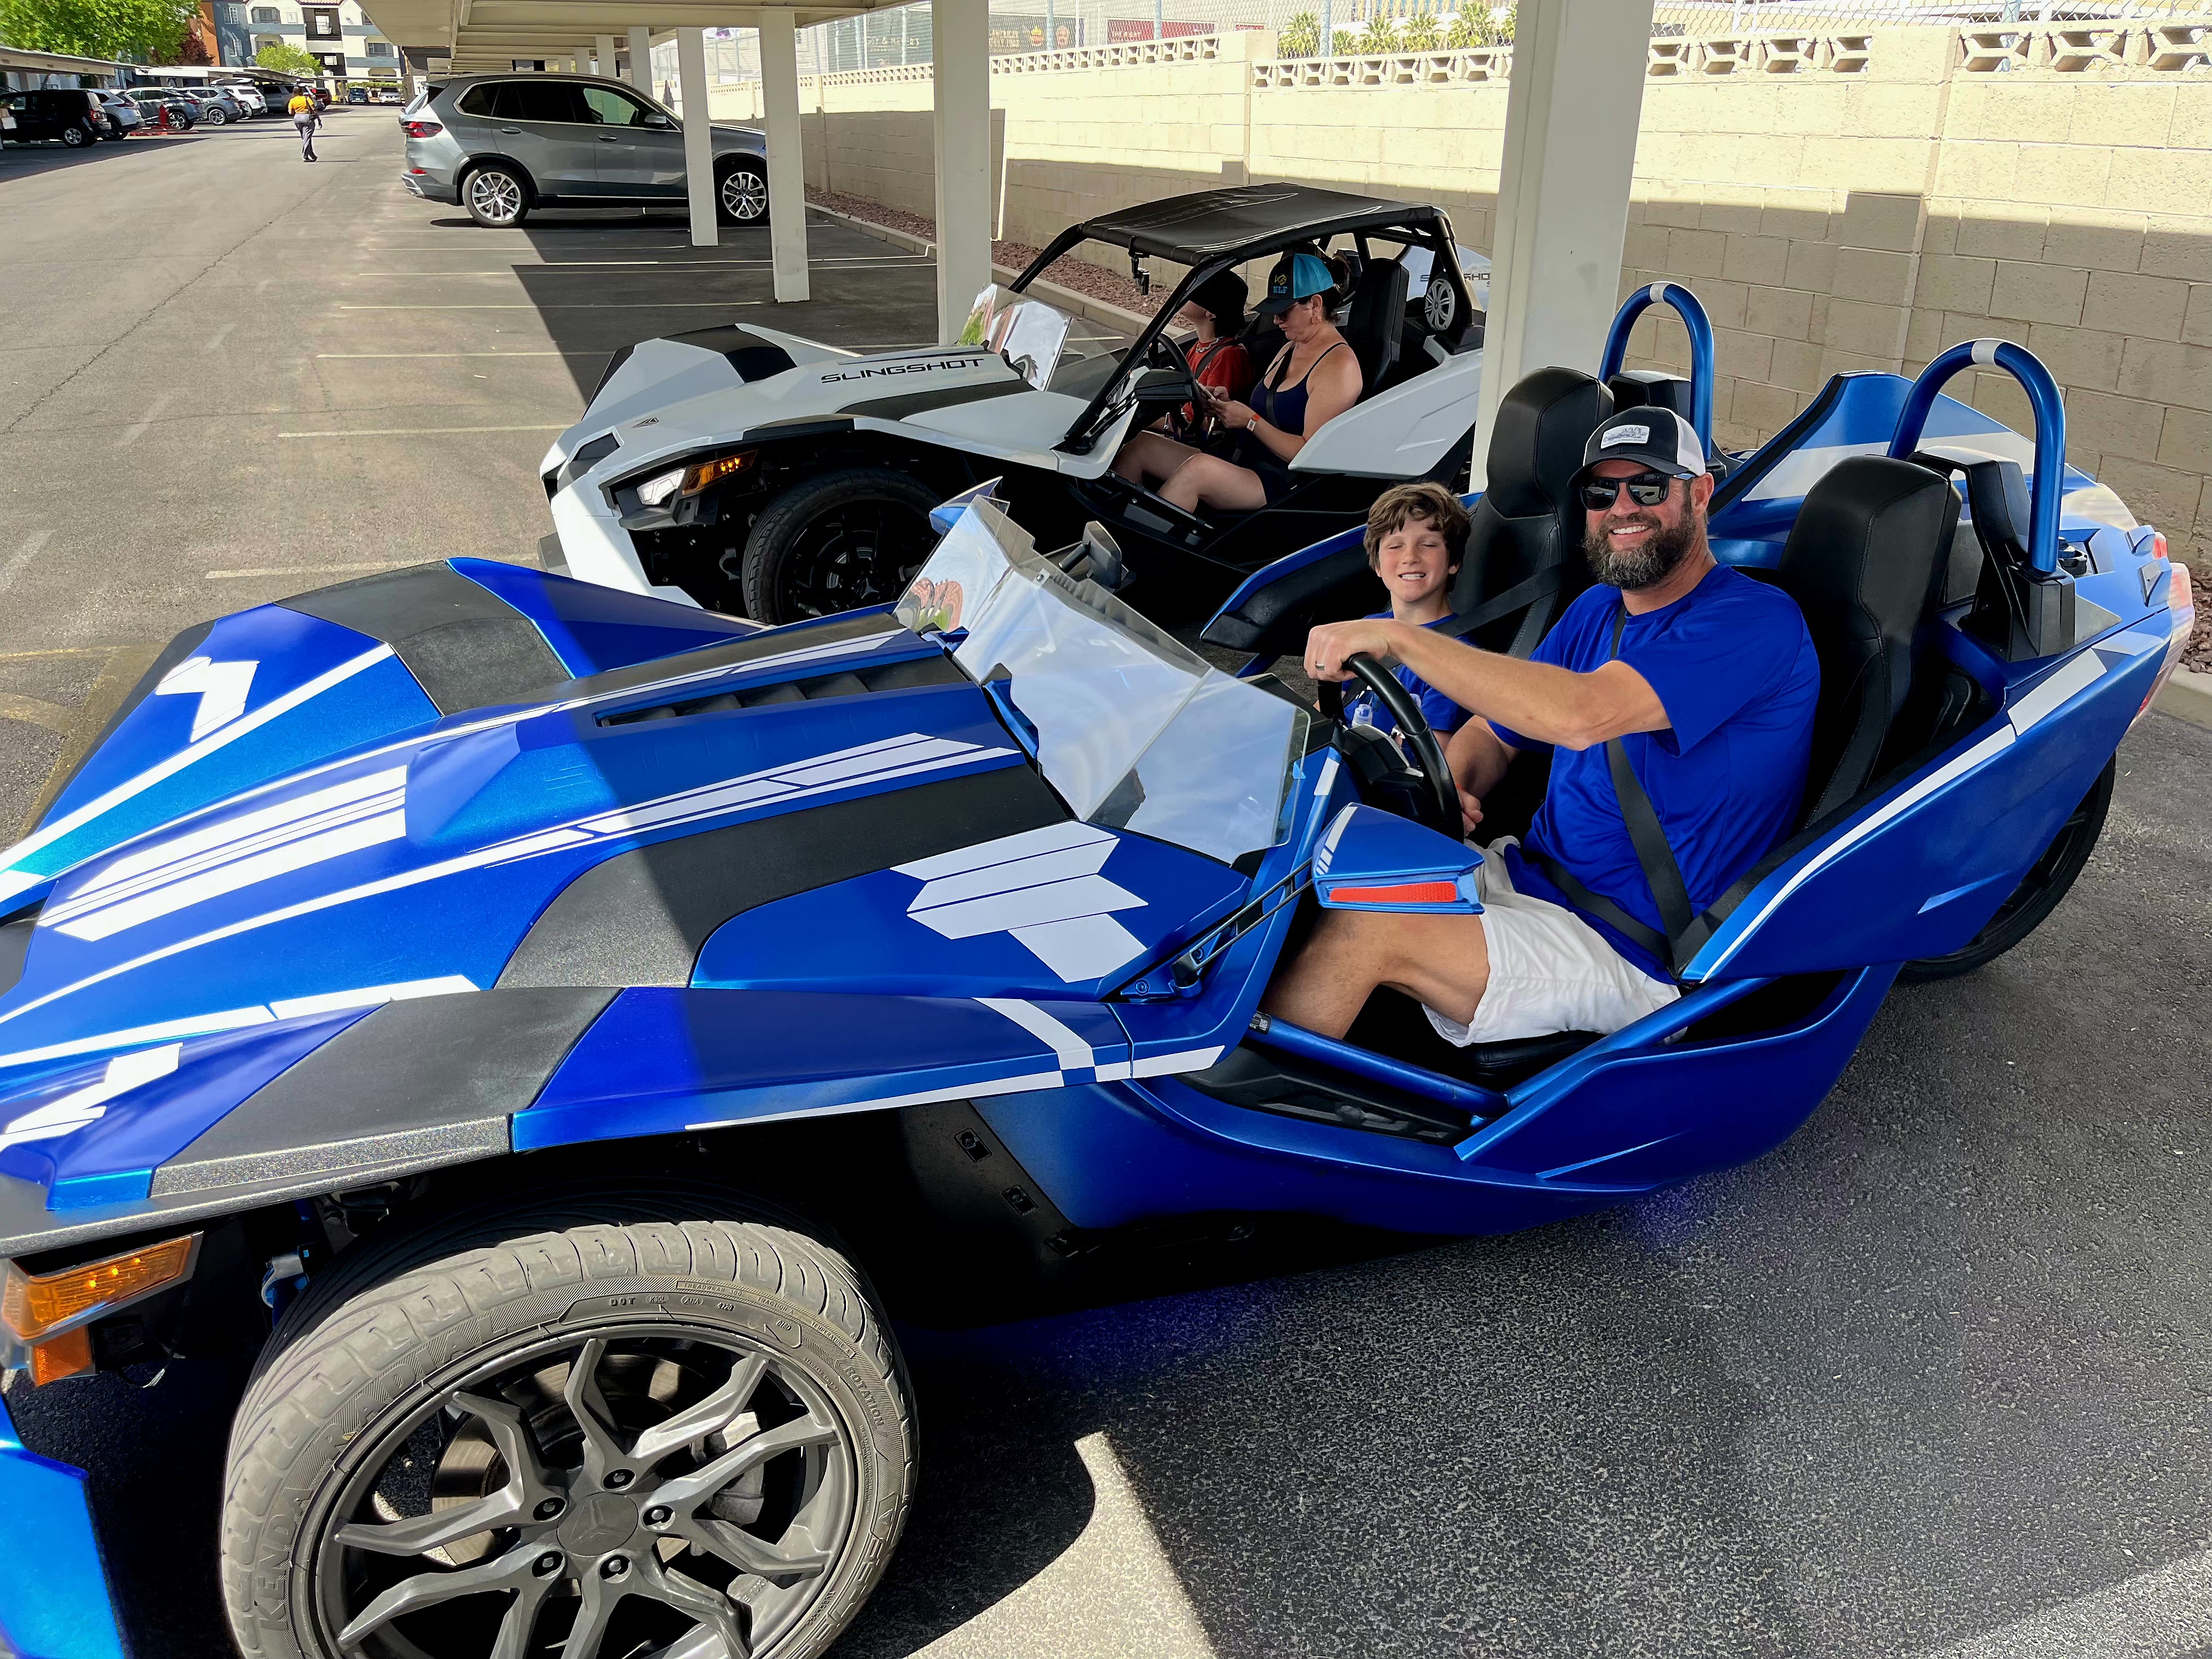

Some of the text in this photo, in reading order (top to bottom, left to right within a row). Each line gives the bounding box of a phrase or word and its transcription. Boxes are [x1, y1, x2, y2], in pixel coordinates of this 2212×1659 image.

[821, 358, 985, 383] SLINGSHOT
[610, 1297, 636, 1306] DOT
[684, 1283, 726, 1293] TREADWEAR
[757, 1296, 788, 1312] TRACTION
[811, 1321, 844, 1347] TEMPERATURE
[313, 1314, 507, 1460] RADIAL
[843, 1365, 885, 1426] ROTATION
[256, 1487, 314, 1630] KENDA
[806, 1589, 836, 1627] TUBELESS
